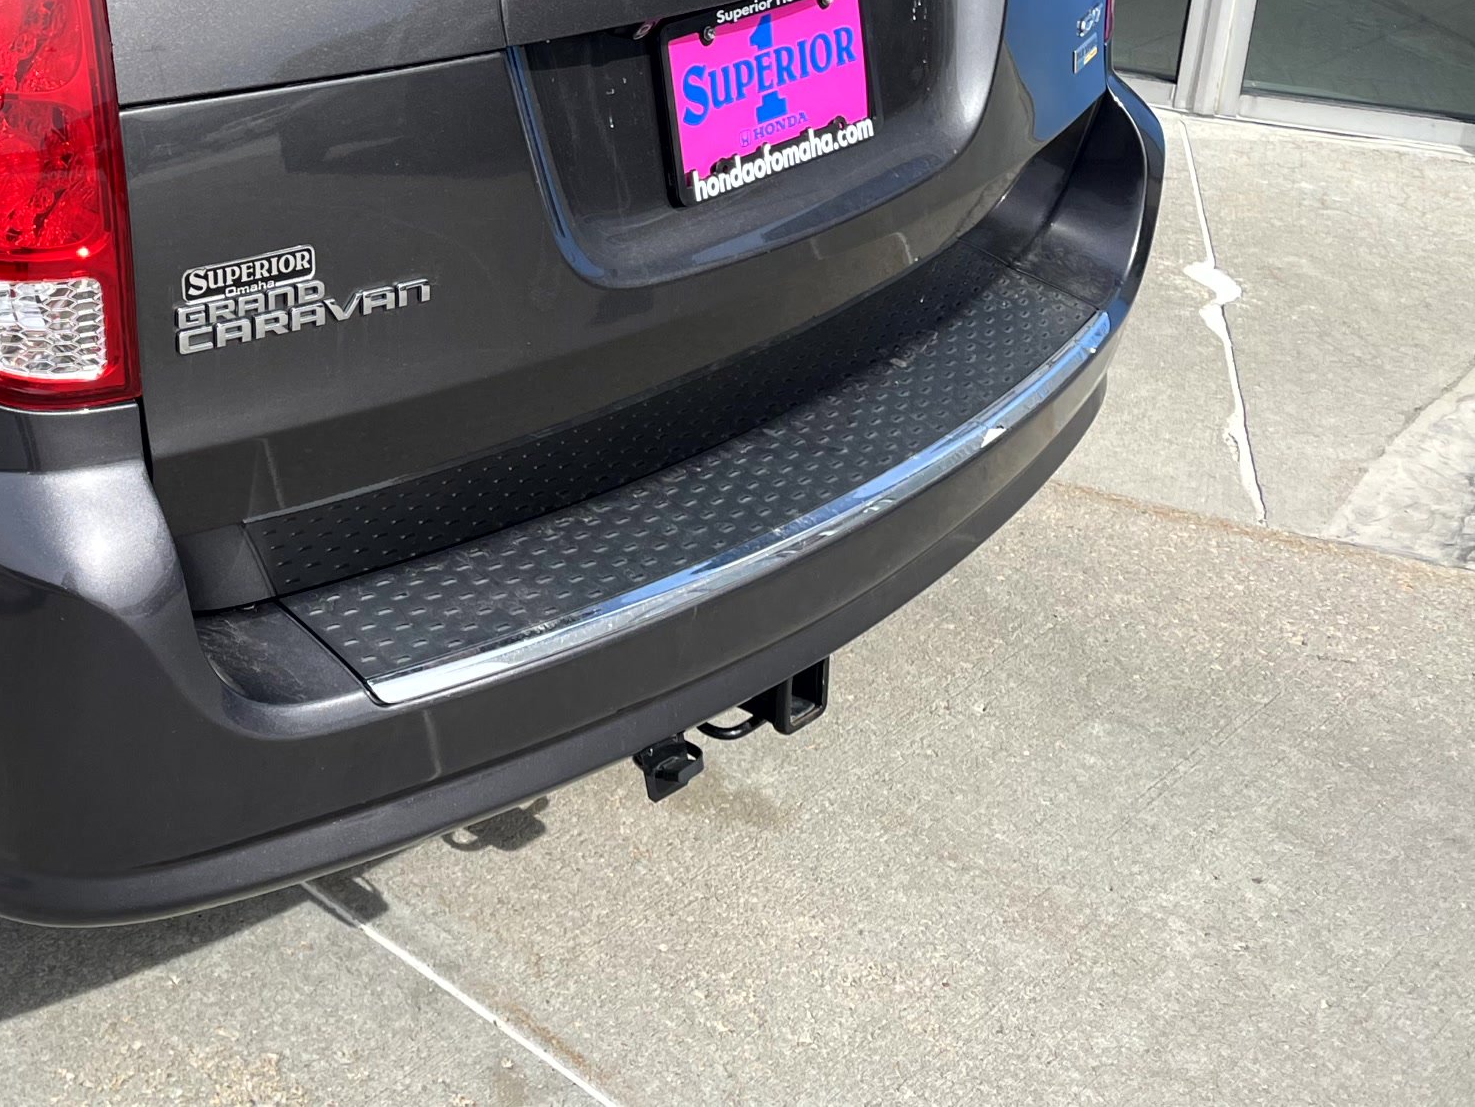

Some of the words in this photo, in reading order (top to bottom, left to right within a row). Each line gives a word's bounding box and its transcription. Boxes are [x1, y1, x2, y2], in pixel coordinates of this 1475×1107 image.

[682, 26, 857, 126] SUPERIOR
[753, 111, 809, 141] HONDA
[693, 117, 874, 202] hondaofomaha.com
[187, 250, 310, 296] SUPERIOR
[225, 279, 275, 298] Omaha
[176, 280, 325, 330] GRAND
[177, 278, 431, 355] CARAVAN
